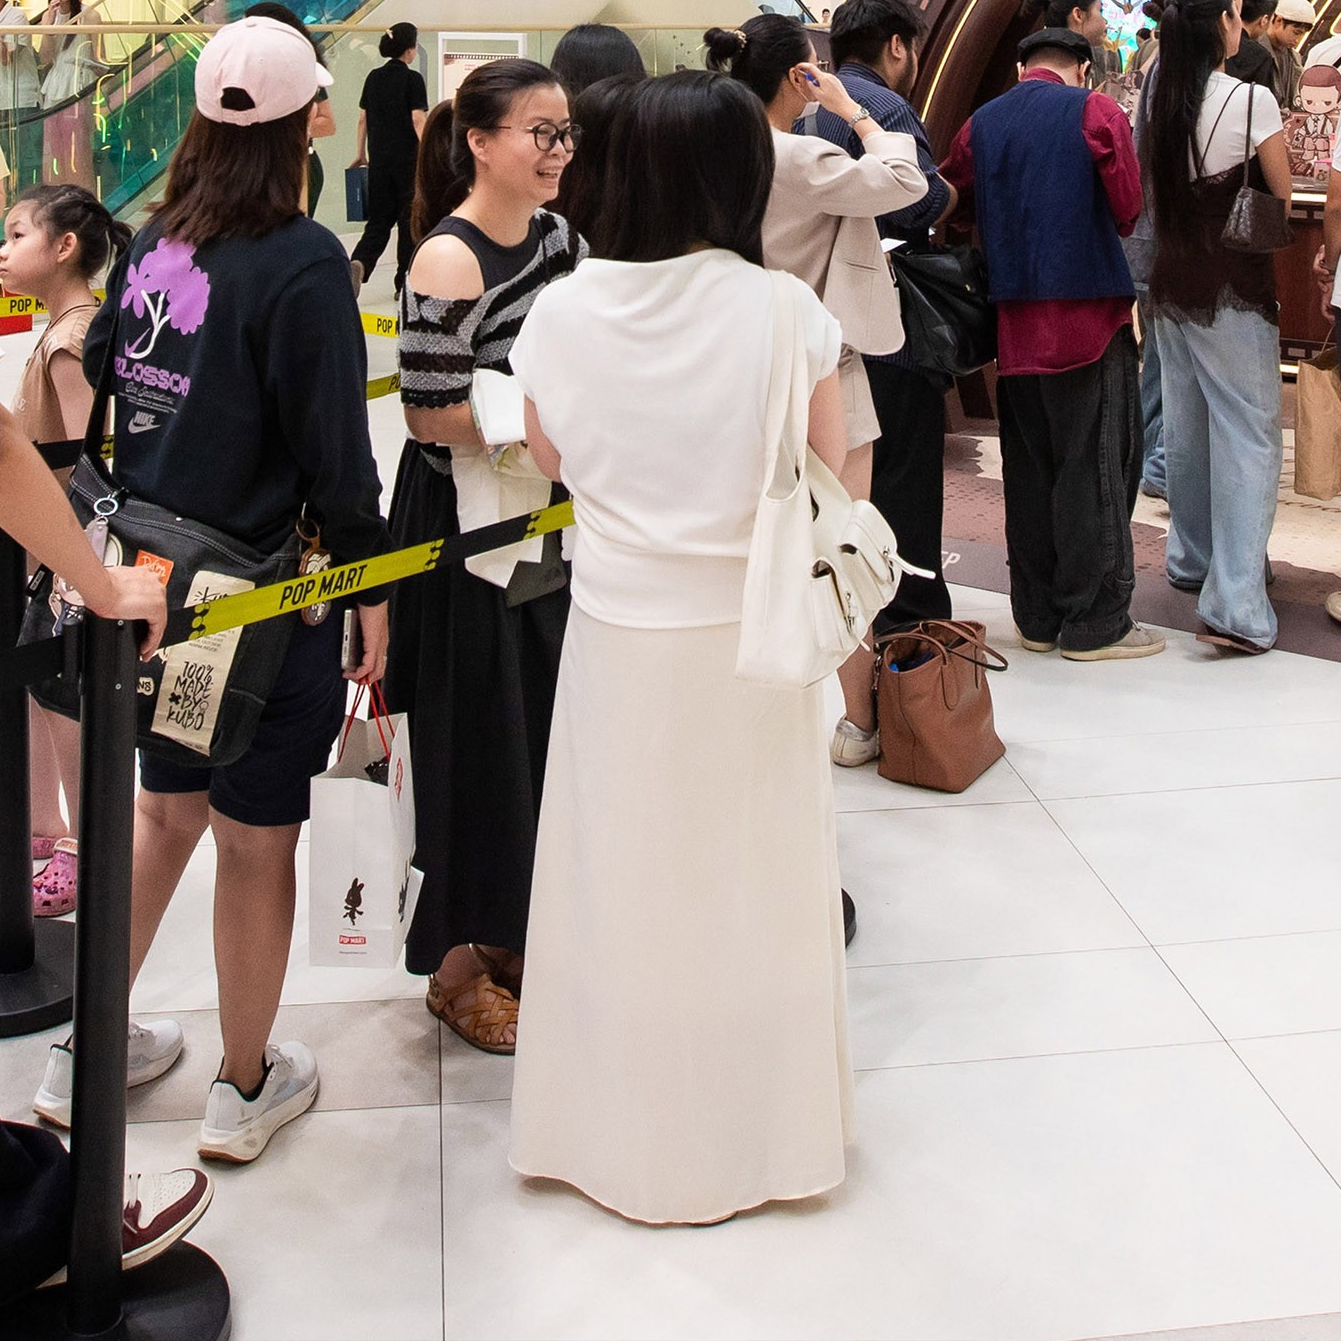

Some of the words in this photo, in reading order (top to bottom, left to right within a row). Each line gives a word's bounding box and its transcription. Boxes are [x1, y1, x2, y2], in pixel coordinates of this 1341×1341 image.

[9, 298, 32, 314] POP
[376, 317, 393, 334] POP
[133, 410, 156, 425] NIKE
[279, 578, 316, 610] POP
[317, 563, 368, 599] MART
[182, 661, 215, 685] 100%
[174, 675, 214, 699] MADE
